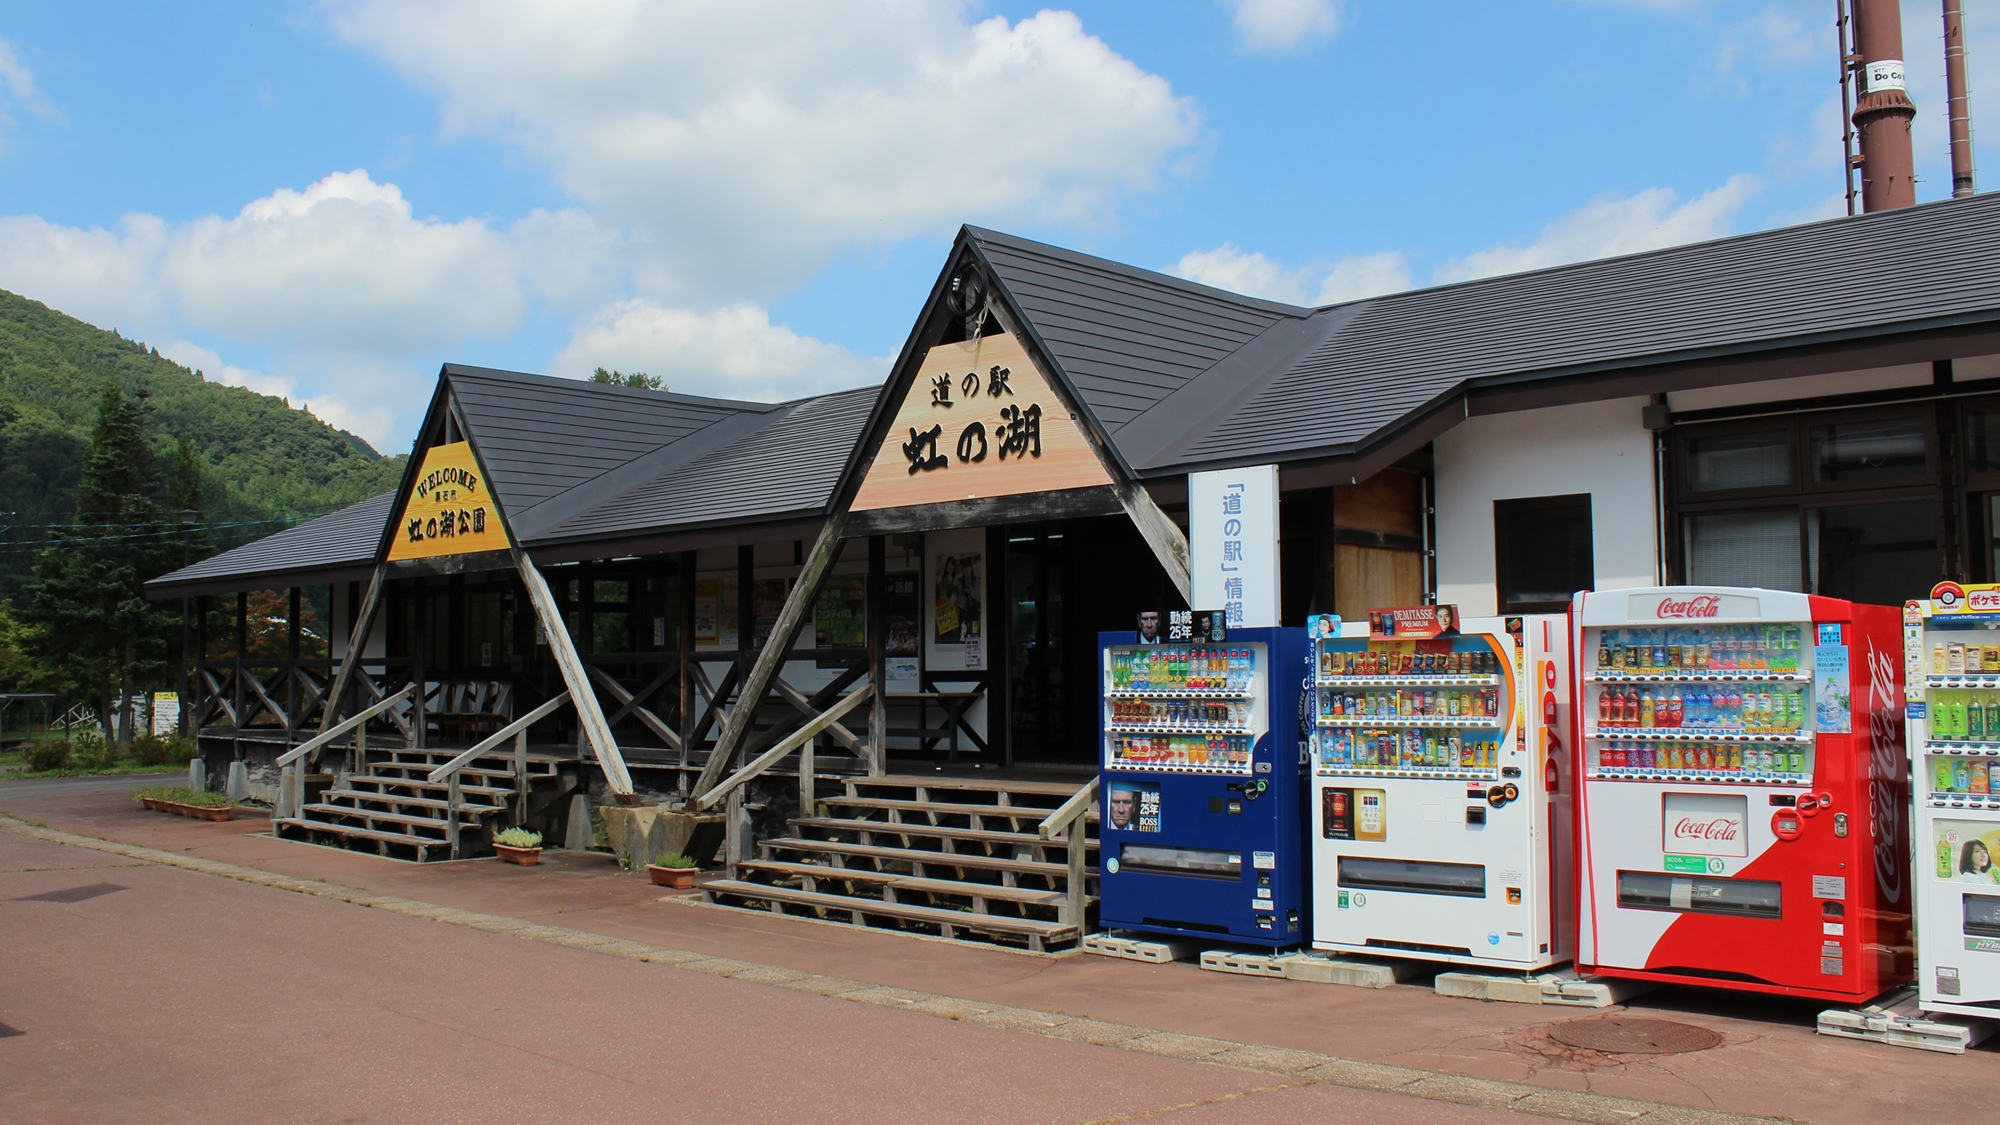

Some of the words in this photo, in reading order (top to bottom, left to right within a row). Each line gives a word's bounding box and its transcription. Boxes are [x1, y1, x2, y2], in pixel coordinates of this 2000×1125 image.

[931, 365, 1014, 408] 道の駅
[902, 403, 1042, 476] 虹の湖
[417, 467, 477, 498] WELCOME
[408, 507, 486, 542] 虹の湖公園
[1221, 483, 1245, 628] 「道の駅」情報
[1169, 611, 1192, 625] 勤続
[1393, 609, 1434, 620] DEMITASSE
[1657, 595, 1721, 619] Coca-Cola
[817, 620, 835, 629] 2017
[1169, 626, 1192, 640] 25年
[1401, 620, 1429, 628] PREMIUM
[1867, 634, 1901, 904] Coca-Cola
[1139, 817, 1158, 826] BOSS
[1140, 803, 1159, 816] 25年
[1674, 817, 1741, 841] Coca-Cola
